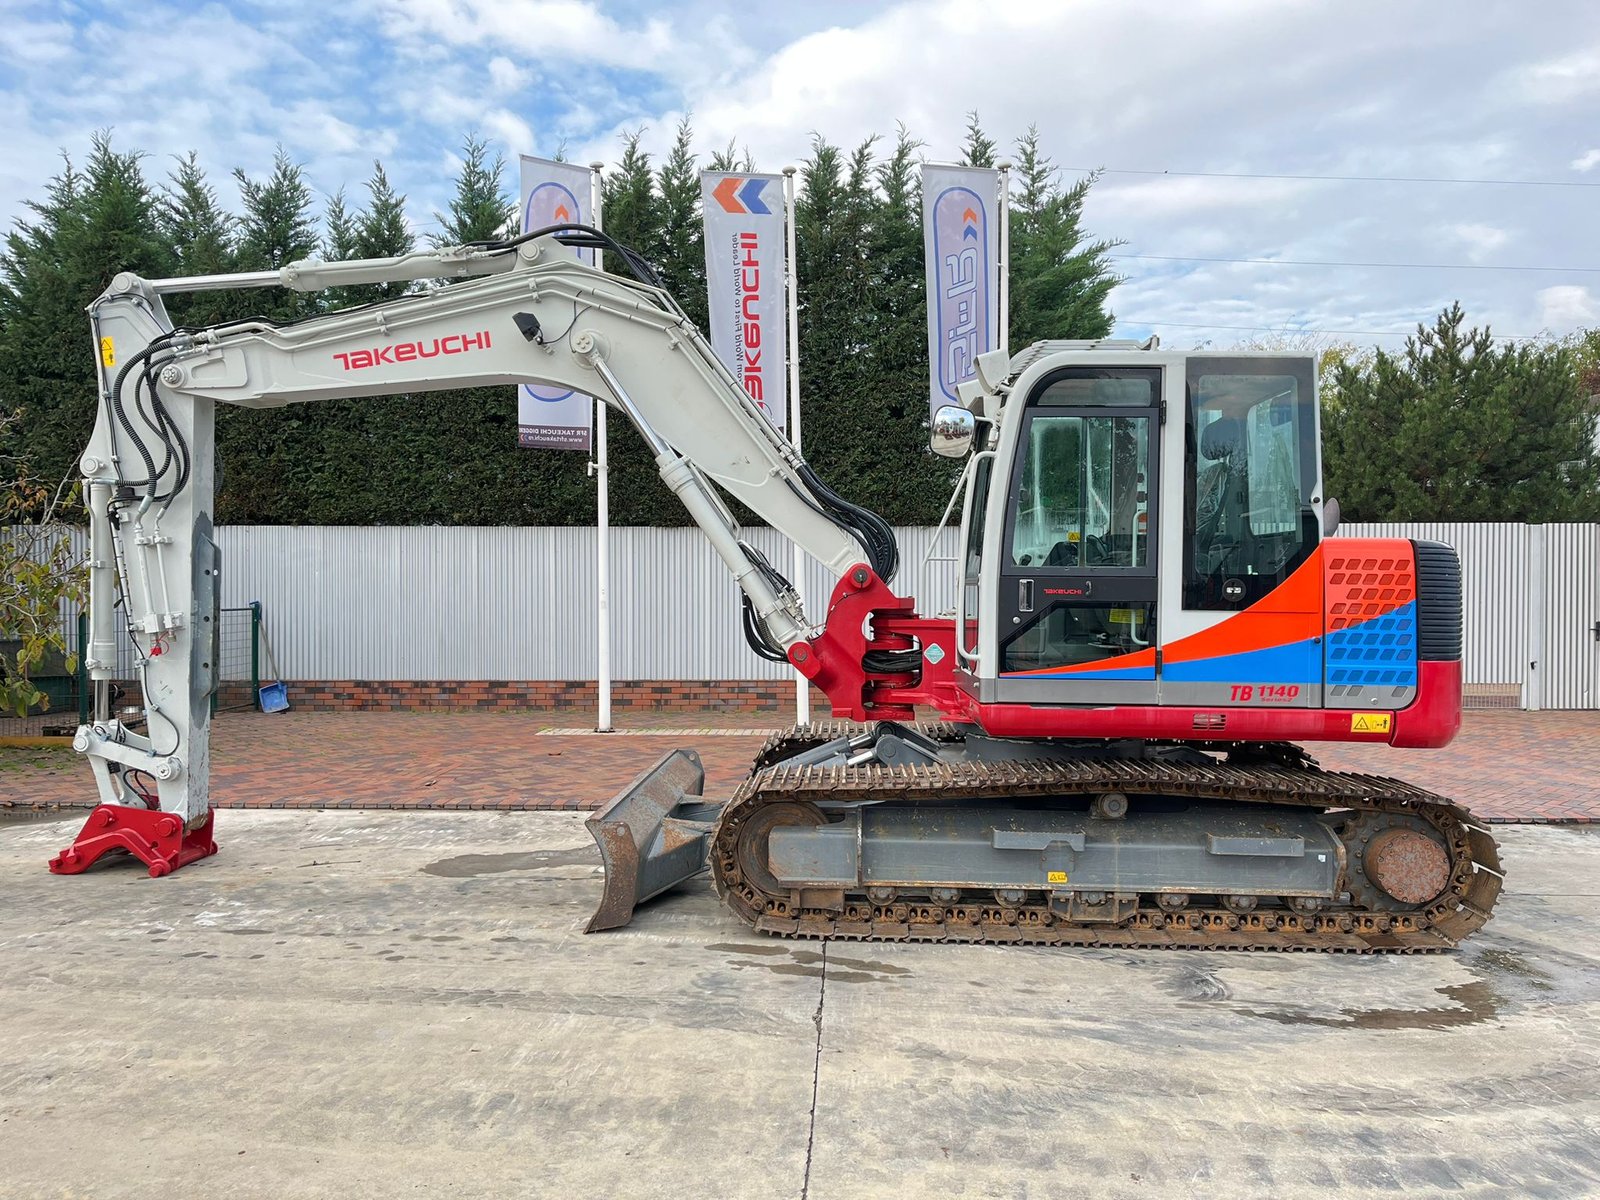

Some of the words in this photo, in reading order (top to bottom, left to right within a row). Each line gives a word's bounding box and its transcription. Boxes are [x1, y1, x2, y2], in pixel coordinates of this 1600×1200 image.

[333, 331, 491, 370] TAKEUCHI
[1231, 685, 1253, 702] TB
[1258, 685, 1299, 698] 1140
